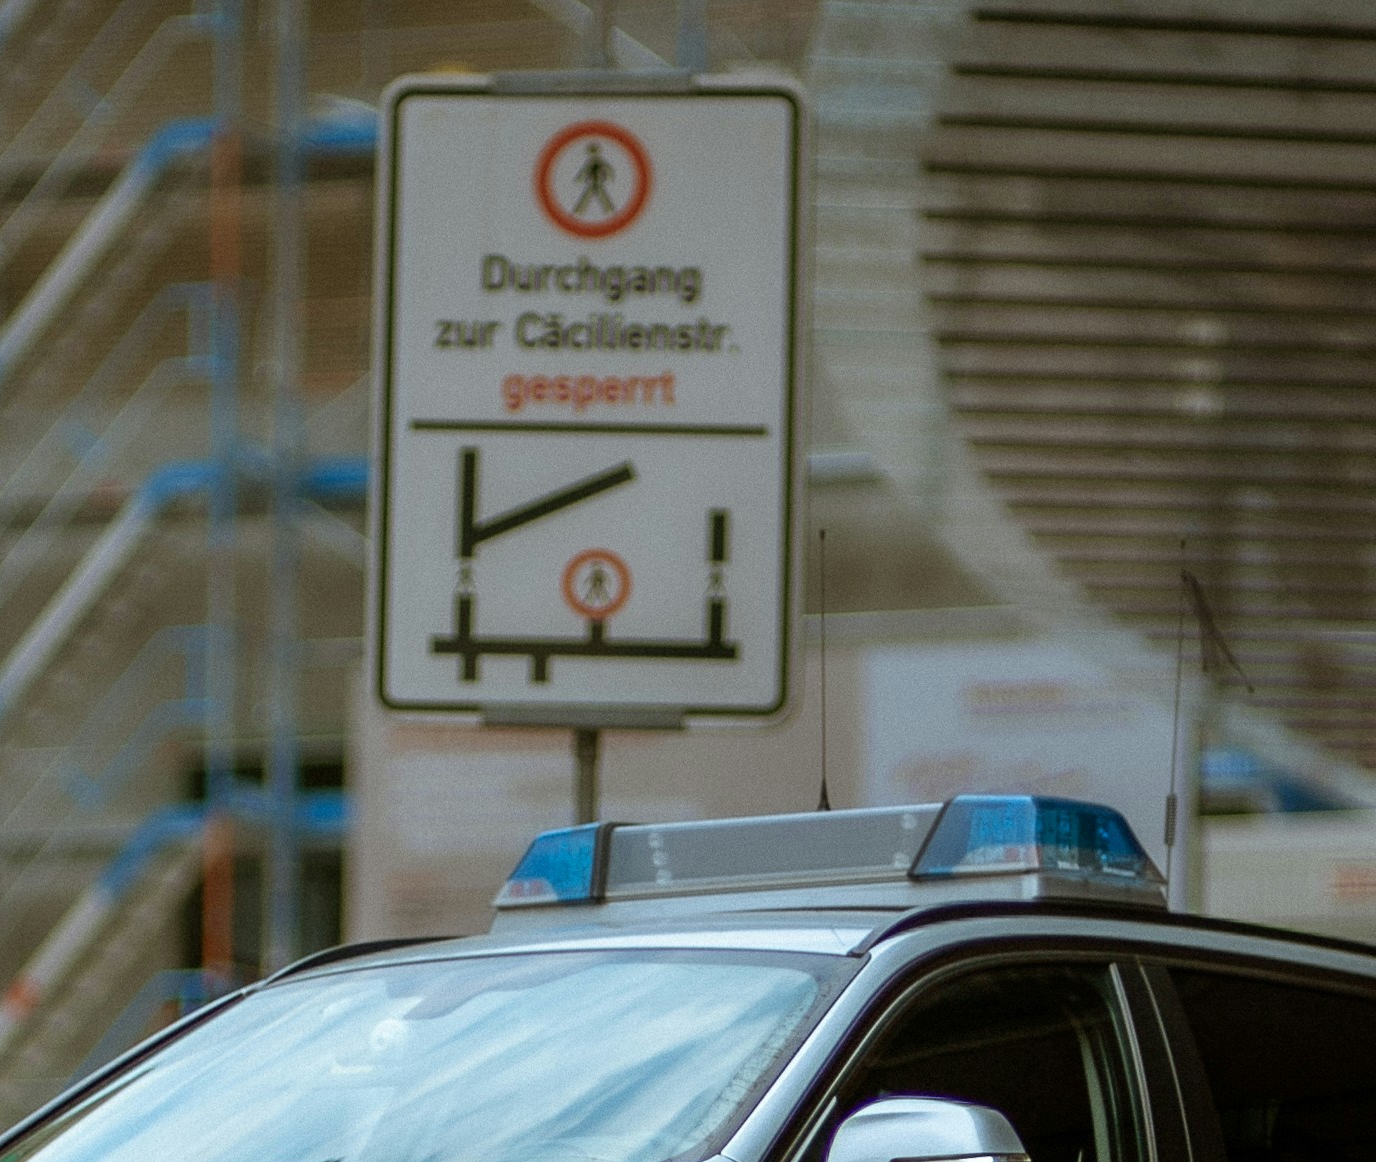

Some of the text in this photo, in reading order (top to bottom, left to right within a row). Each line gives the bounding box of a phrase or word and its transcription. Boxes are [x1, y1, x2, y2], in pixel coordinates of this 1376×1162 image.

[481, 254, 703, 304] Durchgang
[433, 311, 742, 354] zur Cäcilienstr.
[500, 368, 677, 413] gesperrt
